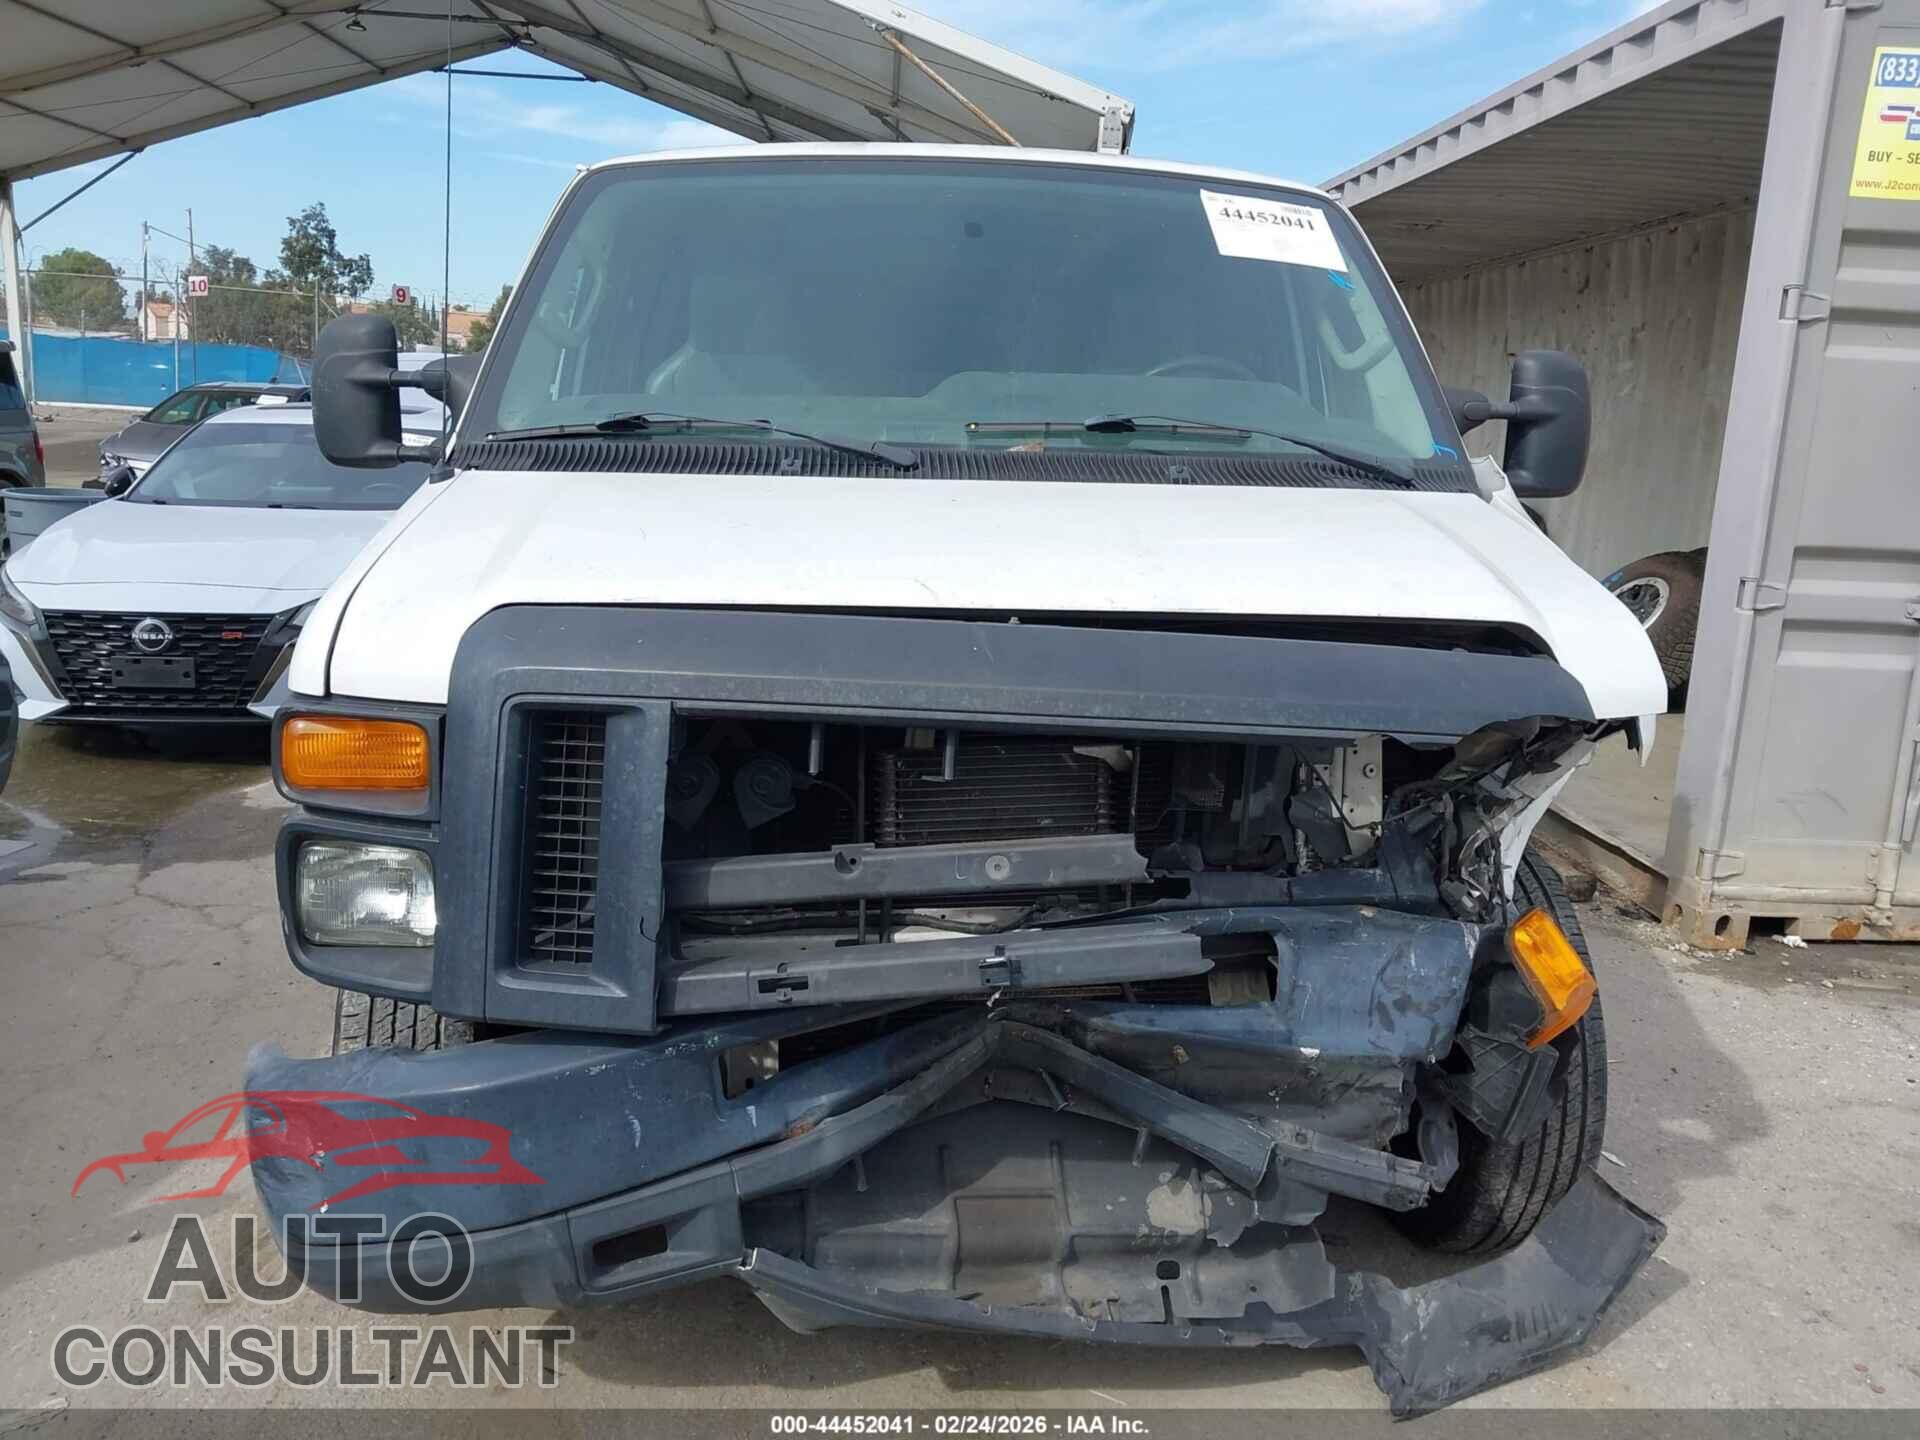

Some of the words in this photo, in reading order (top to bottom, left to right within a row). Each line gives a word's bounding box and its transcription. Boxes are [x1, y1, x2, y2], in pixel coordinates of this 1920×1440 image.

[1868, 150, 1893, 163] BUY
[1907, 152, 1920, 165] SE
[1219, 207, 1315, 231] 44452041
[191, 280, 207, 293] 10
[396, 288, 406, 303] 9
[131, 632, 173, 640] NISSAN
